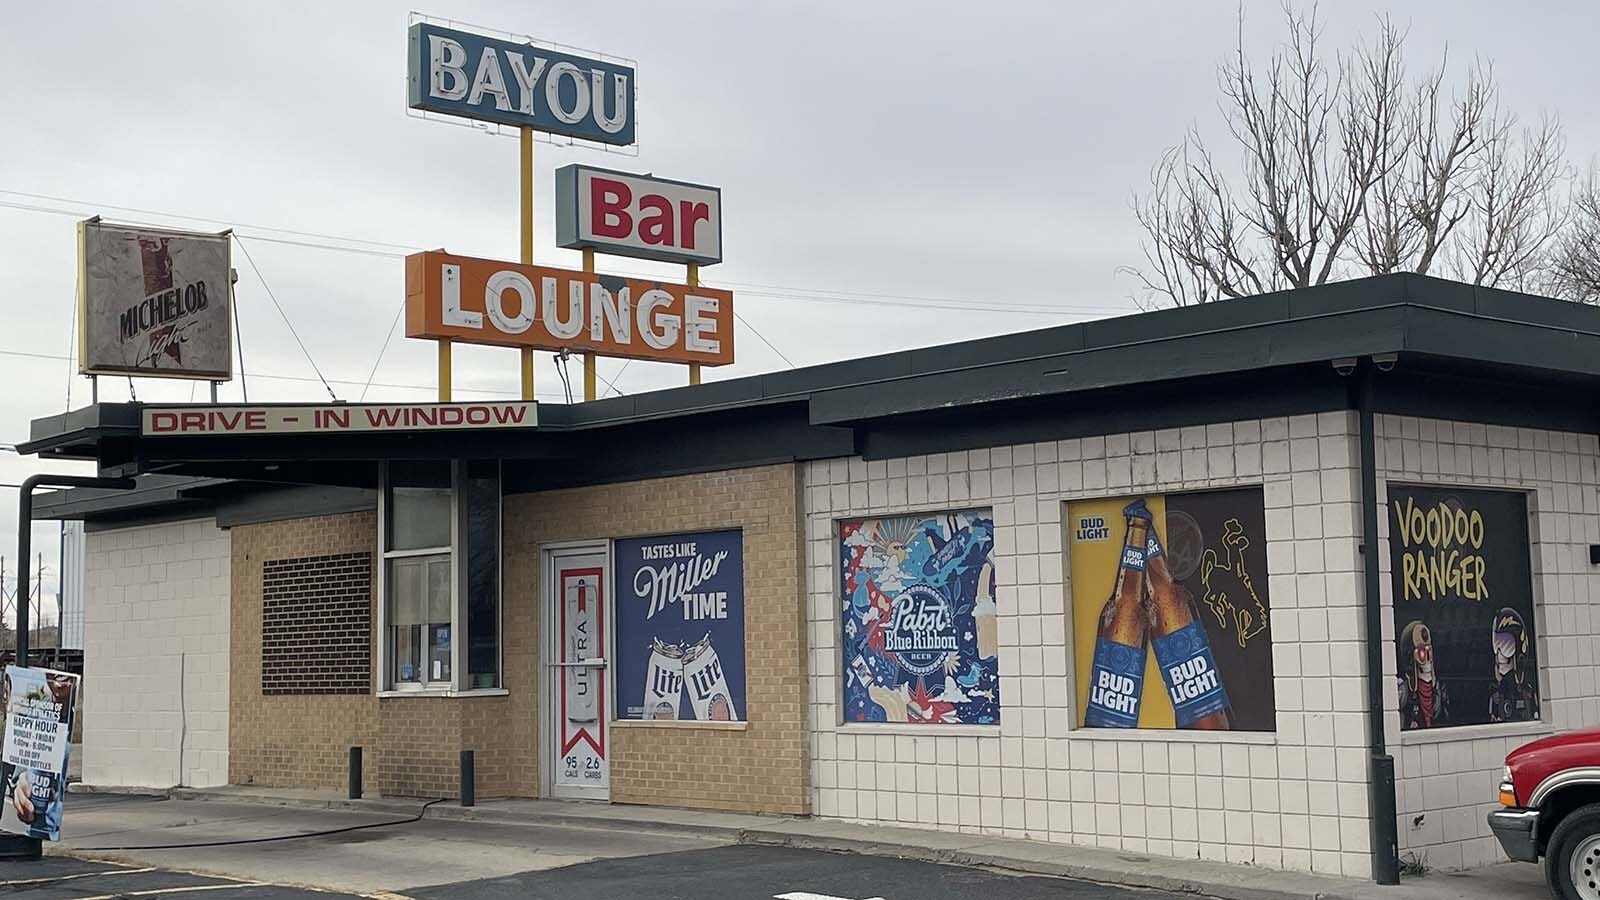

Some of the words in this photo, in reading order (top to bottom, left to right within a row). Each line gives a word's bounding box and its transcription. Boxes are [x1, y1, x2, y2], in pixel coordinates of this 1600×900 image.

[427, 35, 629, 133] BAYOU
[590, 176, 709, 249] Bar
[120, 280, 208, 344] MICHELOB
[441, 263, 720, 354] LOUNGE
[151, 411, 267, 432] DRIVE
[314, 409, 350, 428] IN
[364, 405, 527, 427] WINDOW
[1076, 528, 1109, 540] LIGHT
[1080, 518, 1104, 529] BUD
[1395, 496, 1484, 549] VOODOO
[641, 543, 675, 560] TASTES
[675, 542, 697, 557] LIKE
[1122, 556, 1145, 568] LIGHT
[1126, 549, 1143, 559] BUD
[633, 549, 728, 620] Miller
[1403, 550, 1489, 601] RANGER
[681, 591, 728, 620] TIME
[890, 593, 948, 633] Pabst
[884, 629, 913, 651] Blue
[913, 629, 958, 651] Ribbon
[577, 620, 588, 696] ULTRA
[911, 652, 932, 661] BEER
[1169, 655, 1207, 682] BUD
[652, 664, 682, 698] Lite
[690, 654, 721, 701] Lite
[1098, 669, 1135, 695] BUD
[1170, 669, 1218, 705] LIGHT
[1091, 686, 1138, 714] LIGHT
[13, 716, 34, 730] HAPPY
[35, 720, 58, 733] HOUR
[35, 732, 56, 743] FRIDAY
[20, 758, 30, 766] AND
[30, 759, 52, 770] BOTTLES
[31, 751, 41, 760] OFF
[566, 756, 577, 769] 95
[586, 757, 600, 770] 2.6
[564, 769, 579, 778] CALS
